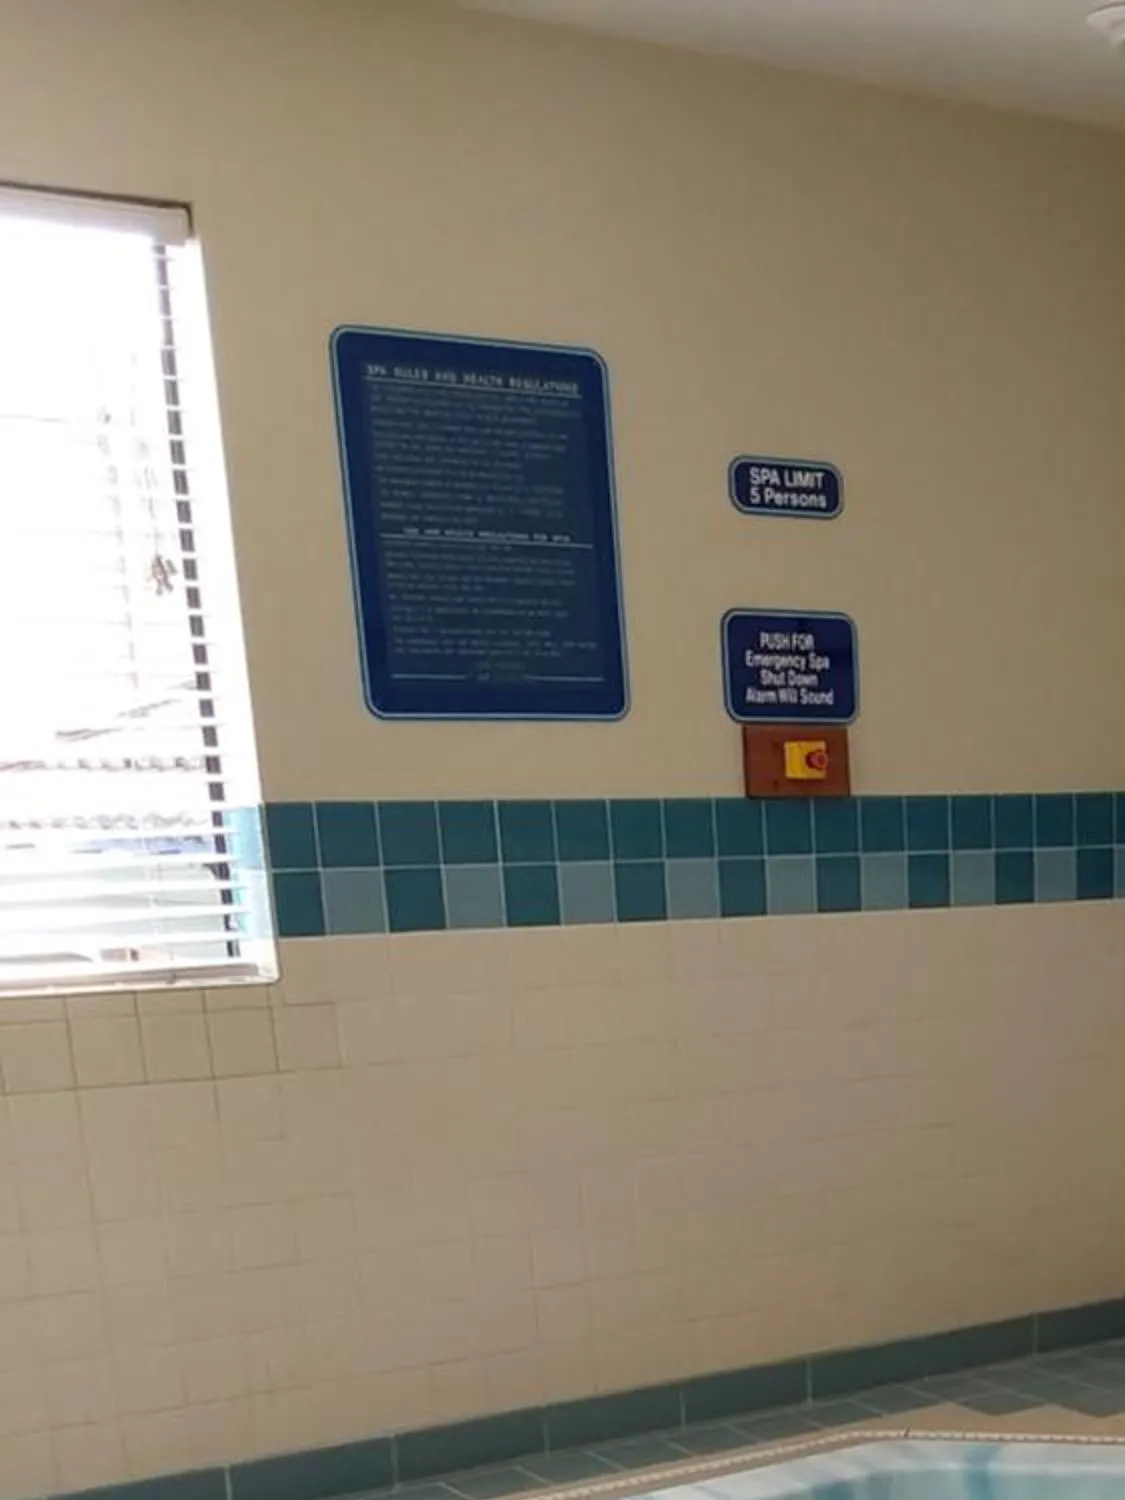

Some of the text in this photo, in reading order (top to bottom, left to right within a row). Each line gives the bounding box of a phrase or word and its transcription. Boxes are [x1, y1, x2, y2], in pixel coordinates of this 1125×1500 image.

[749, 466, 825, 489] SPA LIMIT
[749, 486, 827, 509] 5 Persons
[760, 631, 815, 652] PUSH FOR
[745, 649, 831, 673] Emergency Spa
[760, 668, 820, 687] Shut Down
[745, 687, 835, 705] Alarm Will Sound
